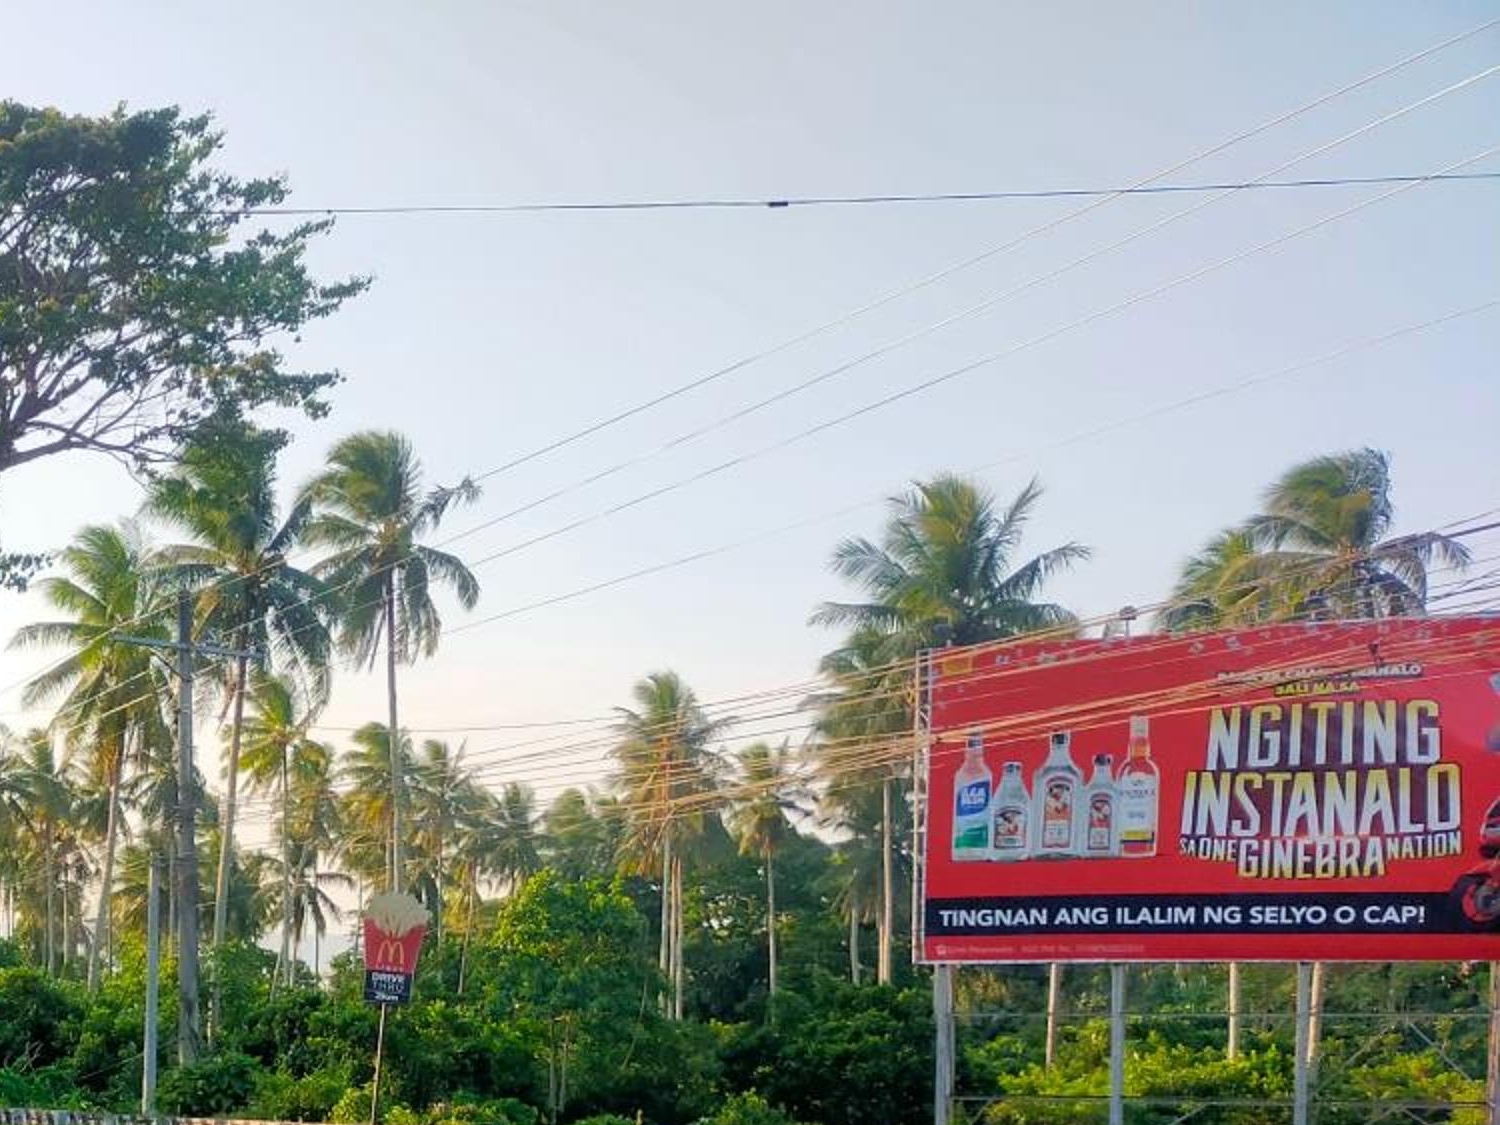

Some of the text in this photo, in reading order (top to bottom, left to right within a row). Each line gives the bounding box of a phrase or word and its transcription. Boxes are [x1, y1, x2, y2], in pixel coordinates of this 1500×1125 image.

[1206, 699, 1441, 770] NGITING
[1181, 763, 1461, 837] INSTANALO
[1179, 830, 1462, 879] SA ONE GINEBRA NATION
[939, 906, 1425, 926] TINGNAN ANG ILALIM NG SELYO O CAP!
